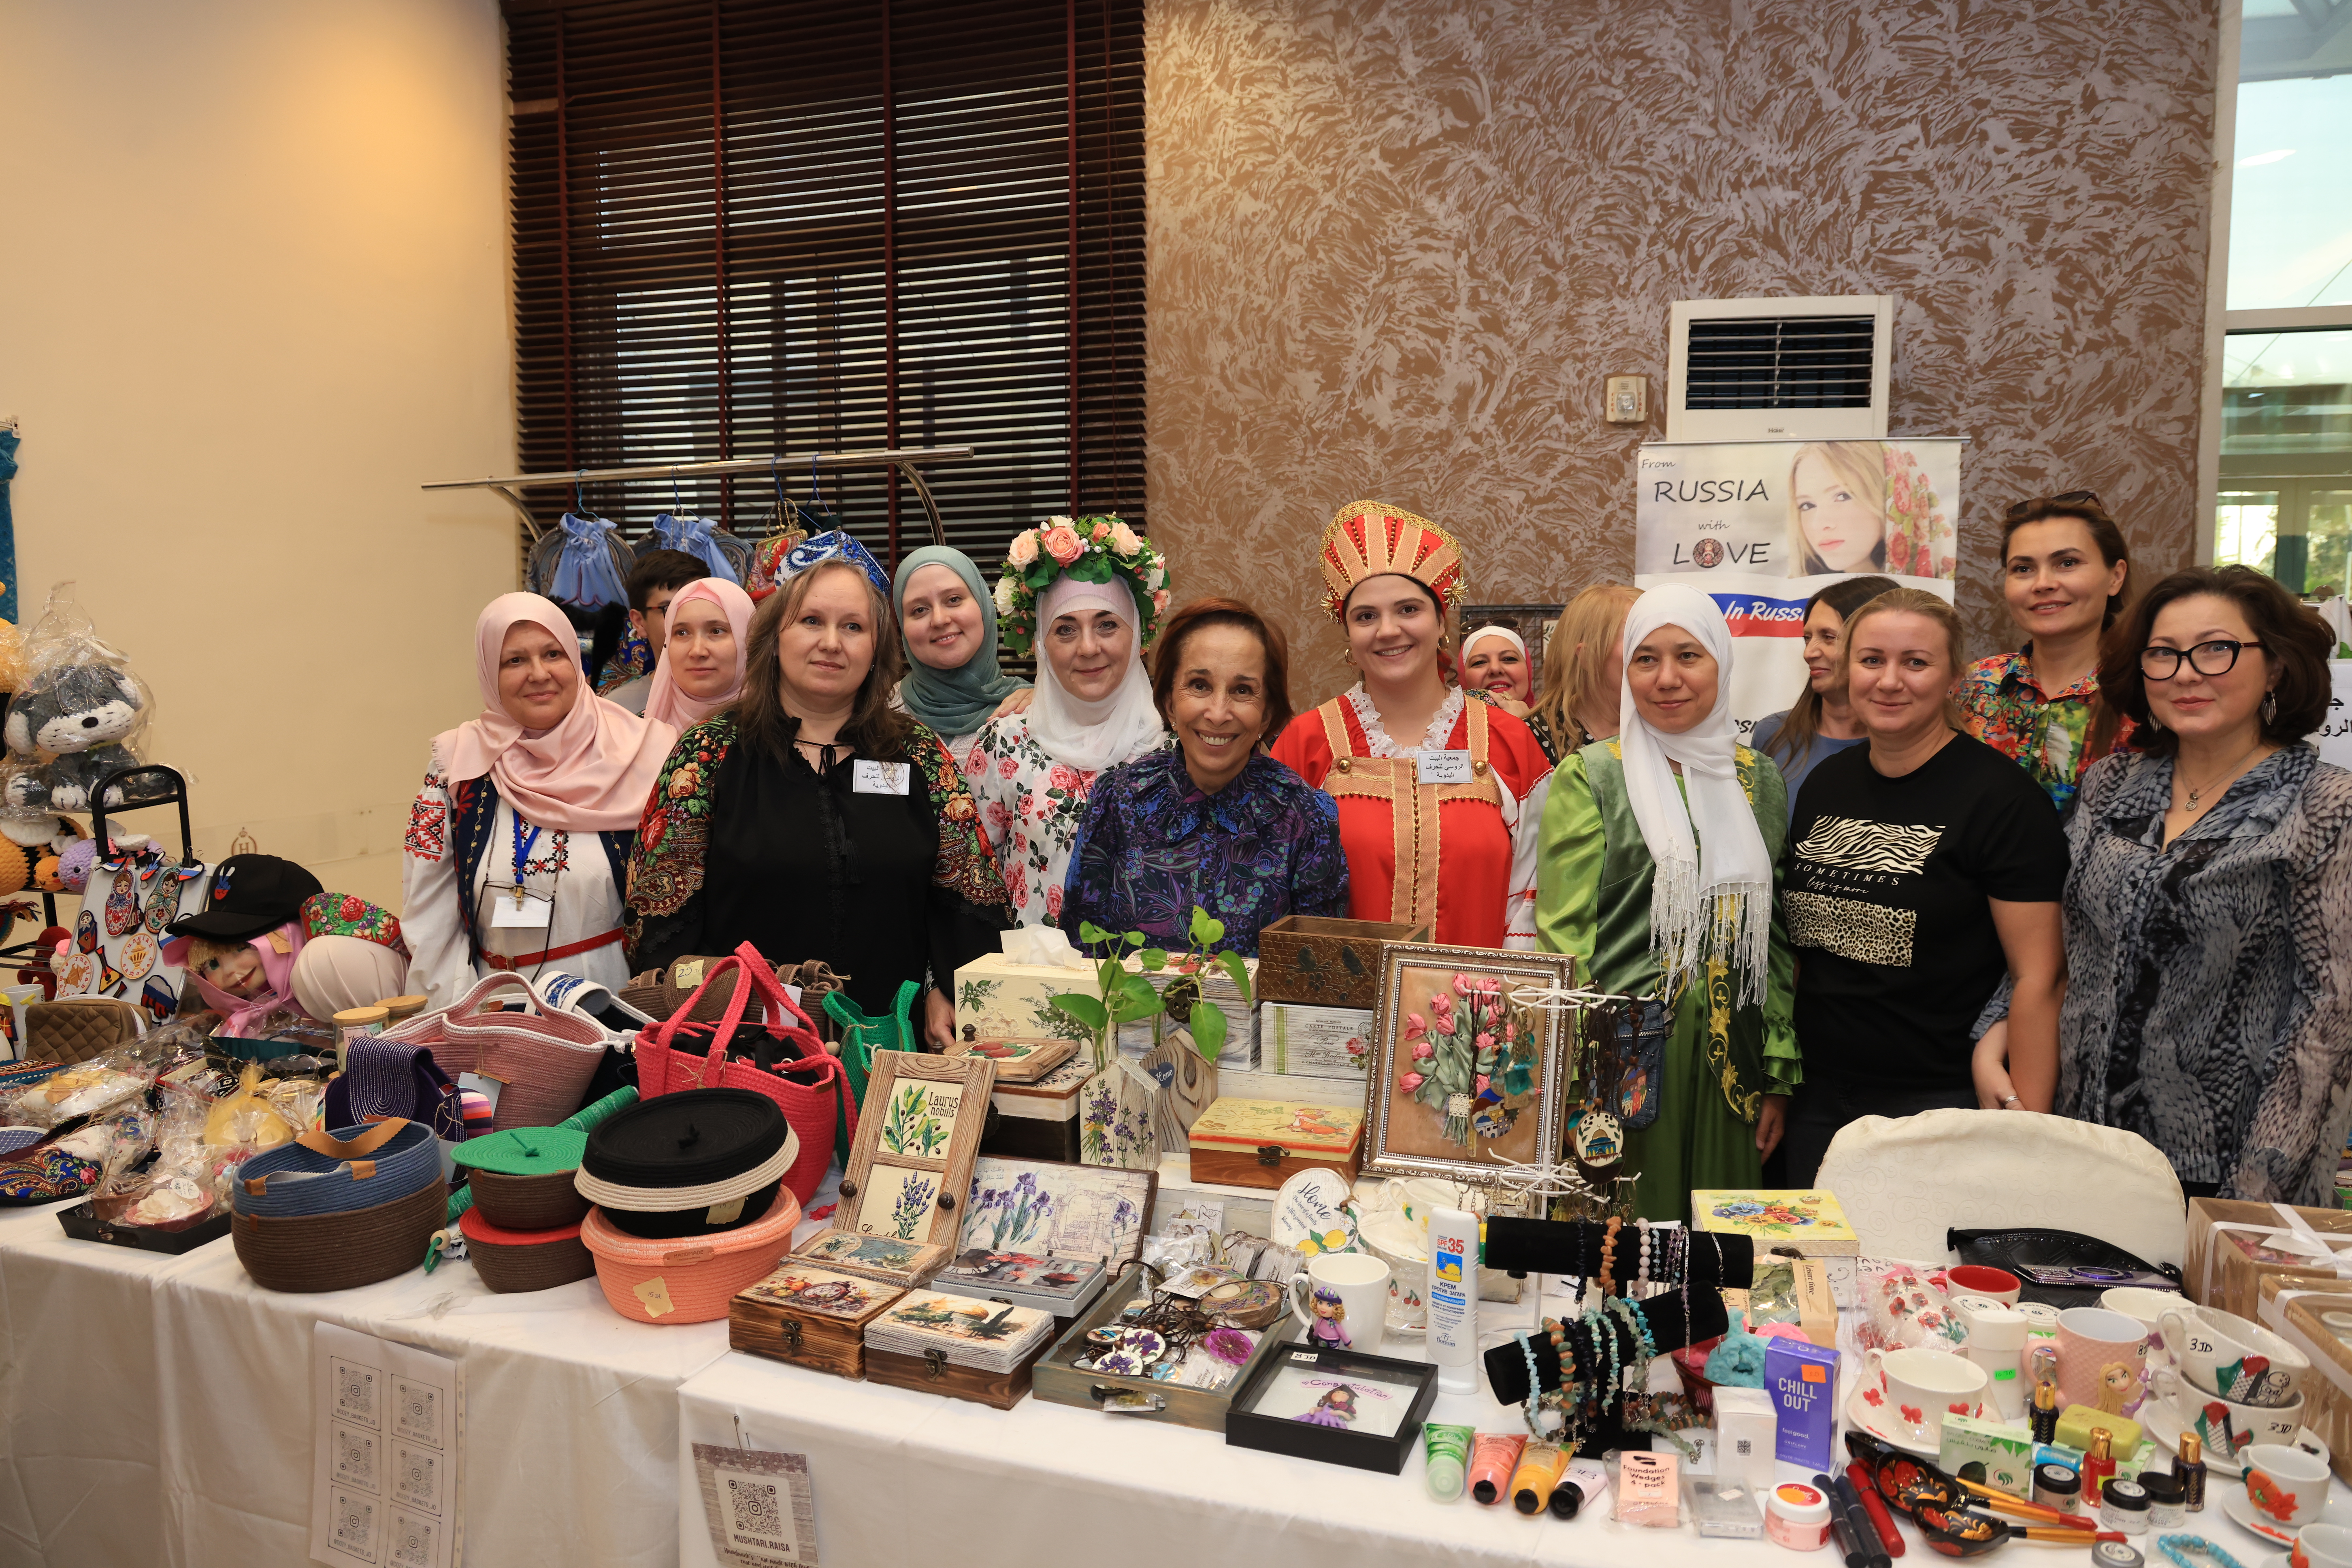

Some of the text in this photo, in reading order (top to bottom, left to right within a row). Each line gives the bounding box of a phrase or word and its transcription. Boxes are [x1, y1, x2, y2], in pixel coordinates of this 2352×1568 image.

[1641, 459, 1676, 469] From
[1655, 480, 1769, 502] RUSSIA
[1698, 520, 1731, 531] with
[1725, 601, 1744, 620] In
[1794, 863, 1899, 886] SOMETIMES
[678, 966, 693, 978] 25
[1155, 1069, 1173, 1082] Home
[928, 1092, 959, 1108] Laurus
[931, 1107, 954, 1117] nobilis
[1297, 1182, 1331, 1219] Home
[1293, 1216, 1306, 1229] greatest
[1307, 1214, 1317, 1226] family
[1437, 1238, 1464, 1254] SPF 35
[1805, 1265, 1814, 1281] Leisure
[1432, 1285, 1448, 1294] ПРОТИВ
[1440, 1282, 1456, 1290] КРЕМ
[1437, 1337, 1455, 1346] floresan
[1779, 1377, 1817, 1400] CHILL
[1784, 1393, 1811, 1412] OUT
[1784, 1440, 1807, 1449] ORIFLAME
[1623, 1465, 1670, 1474] Foundation
[1630, 1472, 1665, 1482] Wedges
[1645, 1480, 1665, 1488] pack
[733, 1534, 790, 1552] MUSHTARI.RAISA
